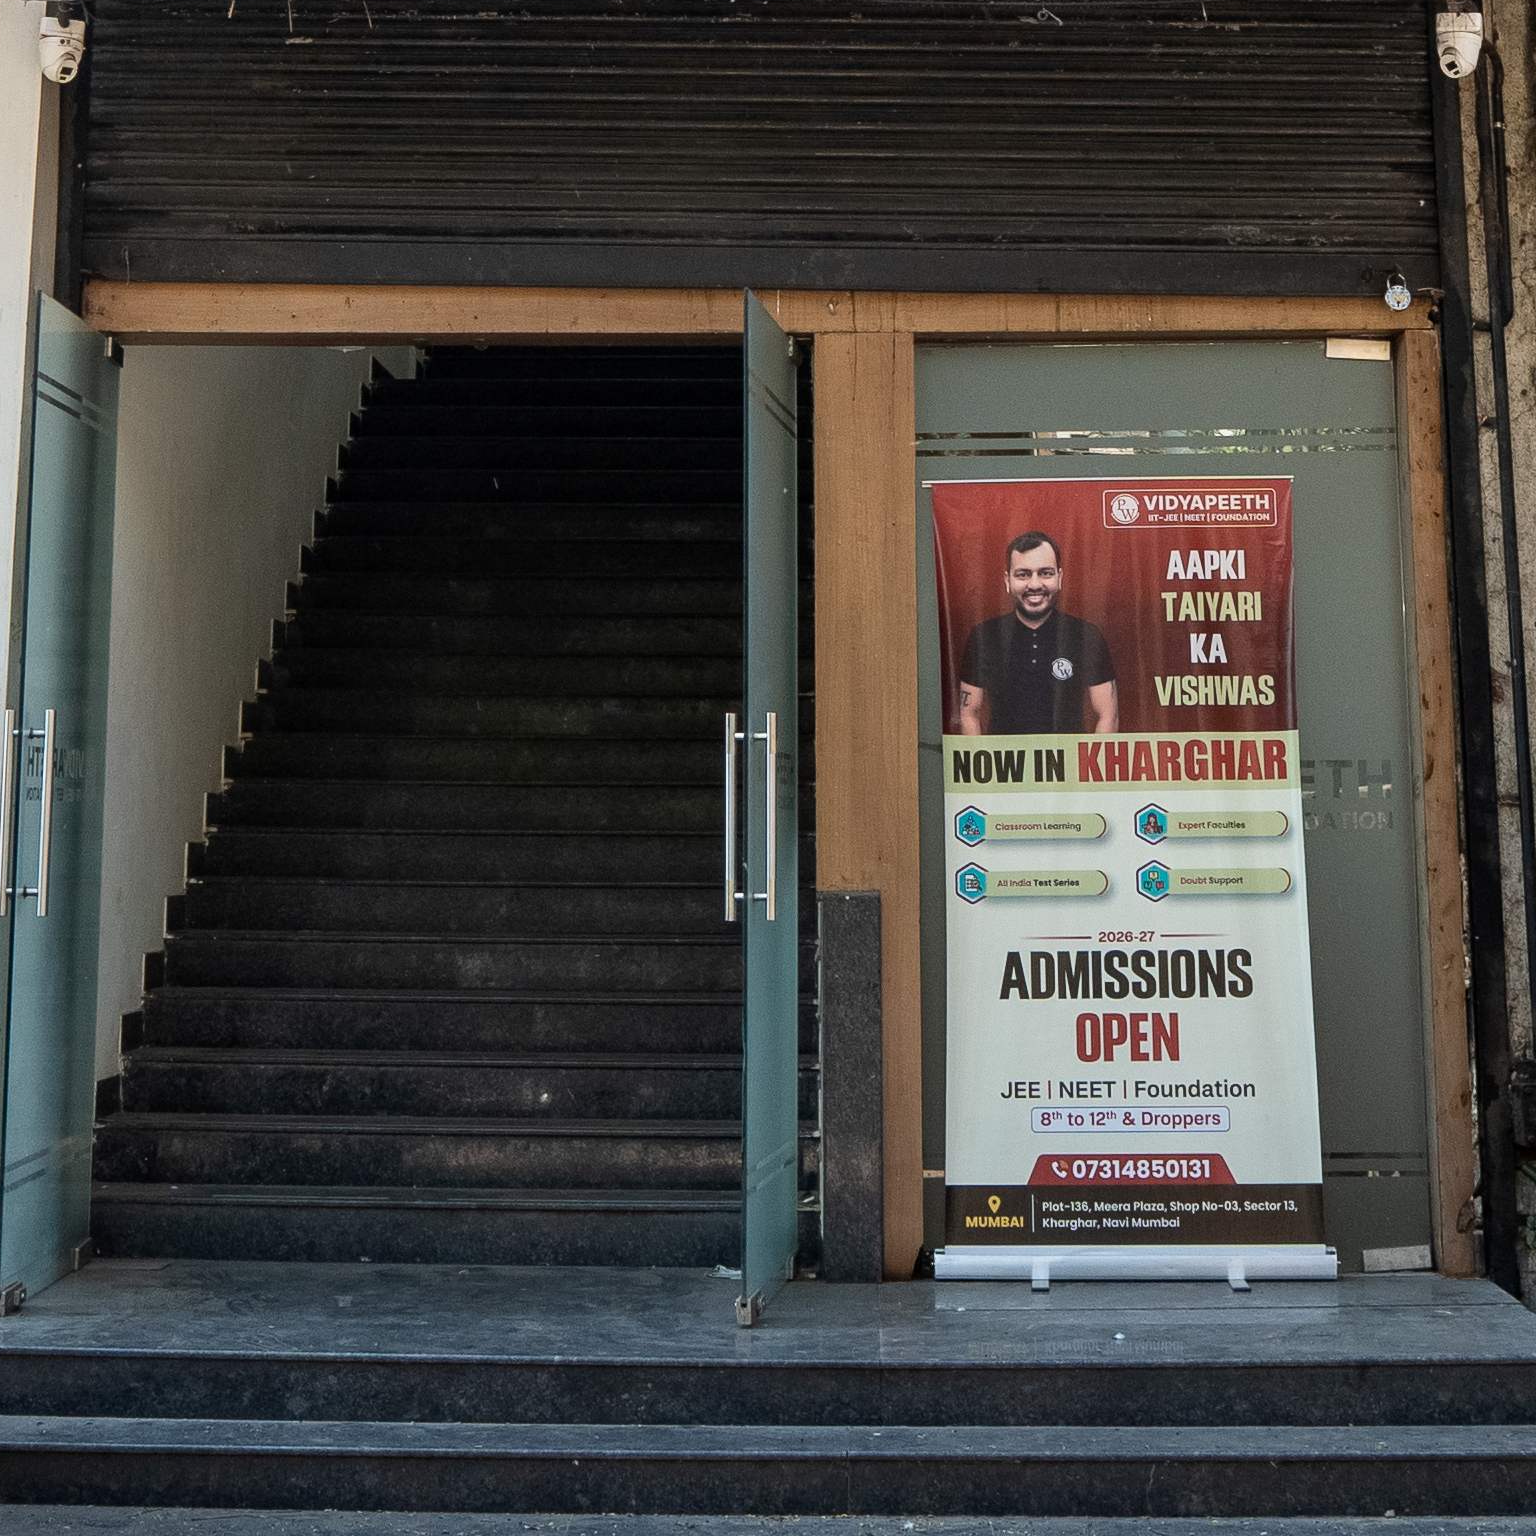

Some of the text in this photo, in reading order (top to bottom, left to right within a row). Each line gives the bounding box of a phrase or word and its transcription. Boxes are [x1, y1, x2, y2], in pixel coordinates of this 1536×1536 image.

[1144, 495, 1269, 511] VIDYAPEETH
[1211, 513, 1270, 521] FOUNDATION
[1167, 549, 1246, 580] AAPKI
[1161, 591, 1262, 622] TAIYARI
[1190, 633, 1228, 663] KA
[1154, 675, 1275, 707] VISHWAS
[953, 749, 1025, 783] NOW
[1034, 749, 1065, 782] IN
[1078, 739, 1287, 782] KHARGHAR
[995, 821, 1081, 833] Classroom Learning
[1178, 820, 1246, 831] Expert Faculties
[997, 878, 1080, 887] All India Test Series
[1180, 876, 1243, 886] Doubt Support
[1098, 930, 1155, 942] 2026-27
[999, 948, 1254, 1000] ADMISSIONS
[1076, 1012, 1180, 1062] OPEN
[1000, 1079, 1256, 1099] JEE NEET Foundation
[1067, 1112, 1084, 1126] to
[1123, 1112, 1135, 1126] &
[1141, 1110, 1221, 1130] Droppers
[1072, 1159, 1210, 1179] 07314850131
[1042, 1201, 1298, 1214] Plot-136, Meera Plaza, Shop No-03, Sector 13,
[966, 1216, 1024, 1228] MUMBAI
[1042, 1217, 1180, 1231] Kharghar, Navi Mumbai
